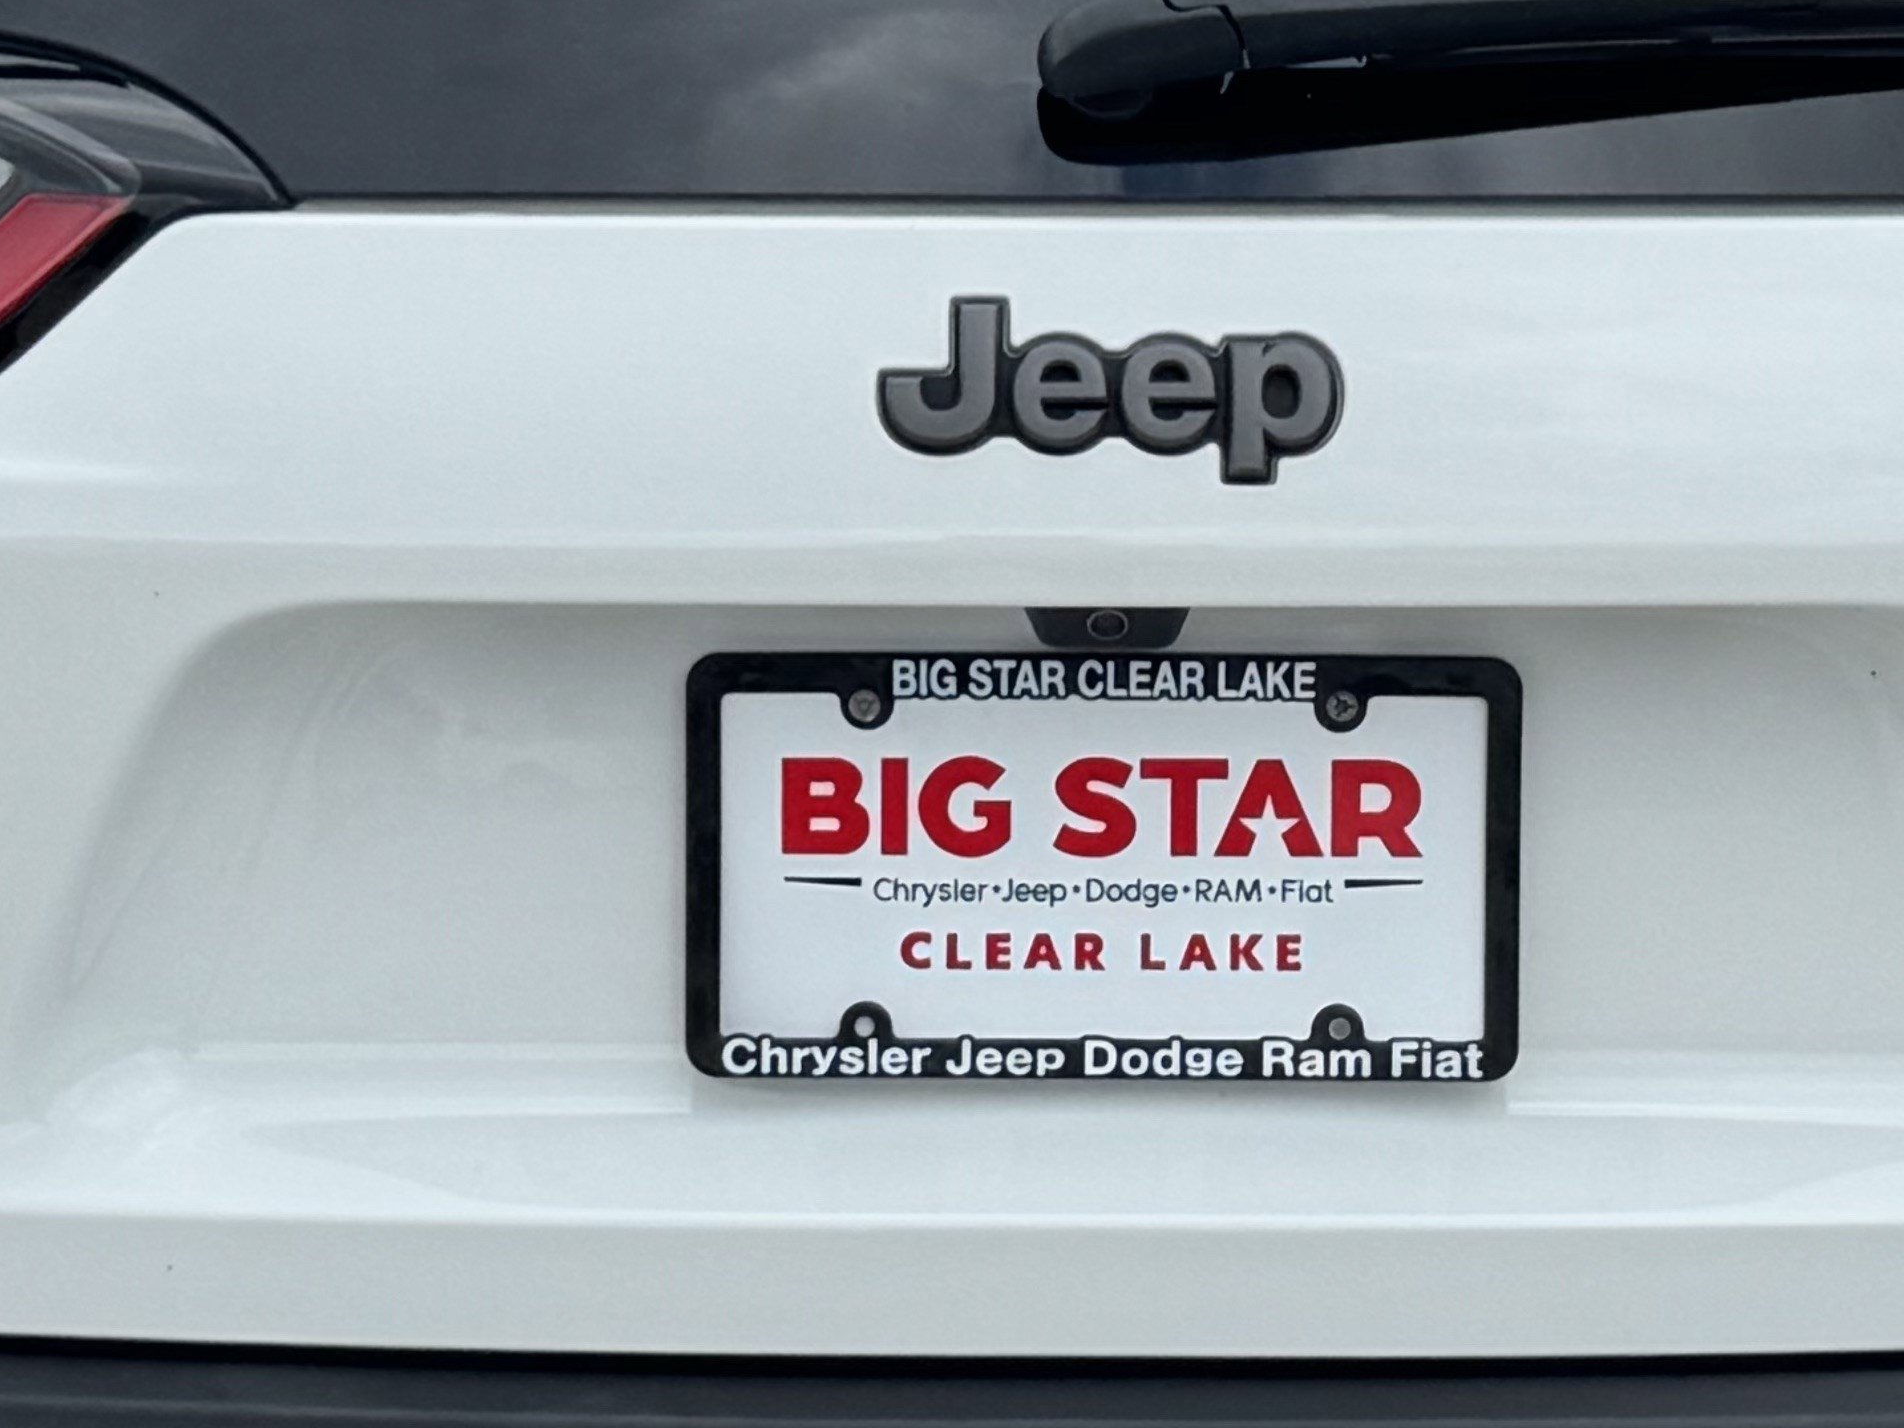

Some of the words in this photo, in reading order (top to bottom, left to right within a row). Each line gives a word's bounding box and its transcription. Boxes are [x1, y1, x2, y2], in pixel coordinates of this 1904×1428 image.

[878, 294, 1345, 485] Jeep
[892, 658, 957, 698] BIG
[967, 658, 1066, 698] STAR
[1077, 659, 1204, 699] CLEAR
[1217, 661, 1317, 699] LAKE
[781, 756, 1012, 857] BIG
[1053, 757, 1424, 858] STAR
[899, 932, 1106, 972] CLEAR
[1140, 933, 1303, 972] LAKE
[721, 1036, 932, 1076] Chrysler
[945, 1038, 1066, 1078] Jeep
[1083, 1039, 1244, 1078] Dodge
[1262, 1041, 1373, 1078] Ram
[1390, 1040, 1485, 1079] Fiat
